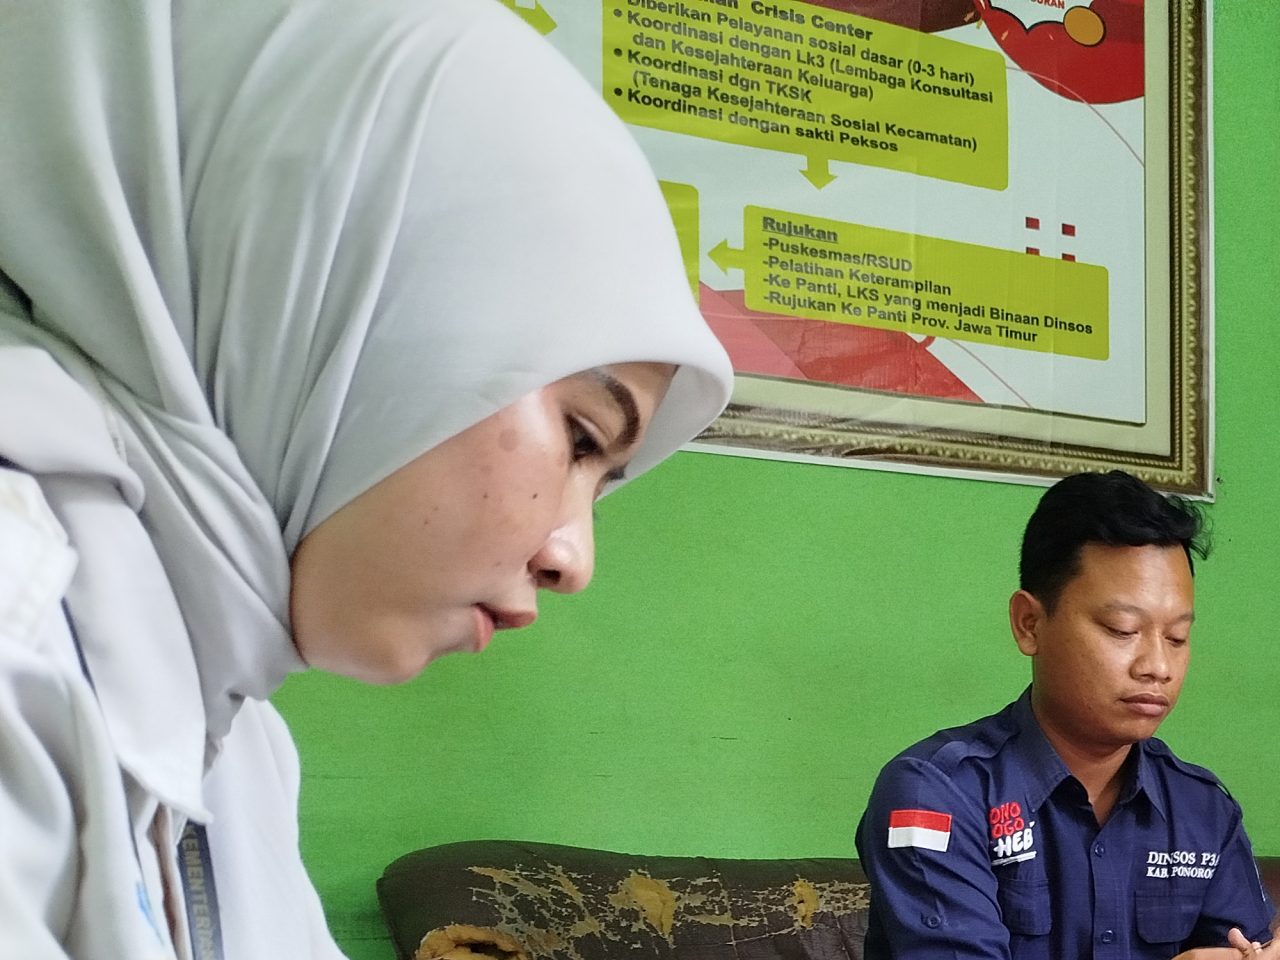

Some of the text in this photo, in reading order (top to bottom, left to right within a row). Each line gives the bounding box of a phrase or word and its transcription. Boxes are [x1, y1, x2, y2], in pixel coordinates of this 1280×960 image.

[751, 1, 873, 41] Crisis Center
[627, 10, 993, 103] Koordinasi dengan Lk3 (Lembaga Konsultasi
[632, 32, 874, 101] dan Kesejahteraan Keluarga)
[717, 12, 804, 44] Pelayanan
[808, 36, 856, 57] sosial
[860, 47, 903, 69] dasar
[907, 58, 936, 77] (0-3
[940, 66, 975, 87] hari)
[627, 50, 812, 103] Koordinasi dgn TKSK
[627, 88, 899, 152] Koordinasi dengan sakti Peksos
[633, 70, 978, 152] (Tenaga Kesejahteraan Sosial Kecamatan)
[762, 216, 838, 243] Rujukan
[762, 237, 913, 273] -Puskesmas/RSUD
[762, 255, 951, 296] -Pelatihan Keterampilan
[763, 274, 1093, 334] -Ke Panti, LKS yang menjadi Binaan Dinsos
[763, 291, 1038, 342] -Rujukan Ke Panti Prov. Jawa Timur
[990, 802, 1021, 825] ONO
[992, 817, 1025, 838] OGO
[1146, 851, 1196, 866] DINSOS
